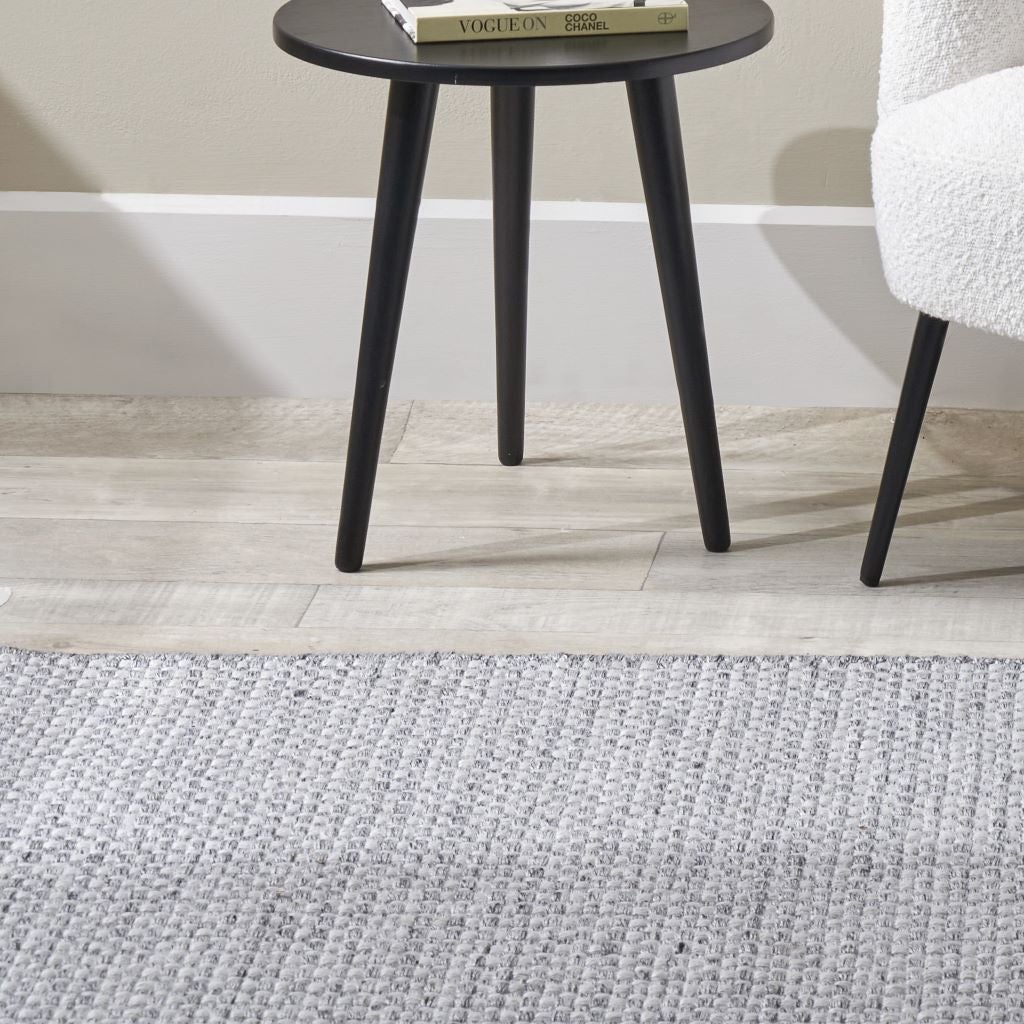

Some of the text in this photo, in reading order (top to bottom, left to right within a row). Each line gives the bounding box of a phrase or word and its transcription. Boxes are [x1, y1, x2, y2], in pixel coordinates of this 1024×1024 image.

[564, 13, 598, 22] COCO
[459, 16, 547, 33] VOGUE ON
[564, 21, 609, 31] CHANEL
